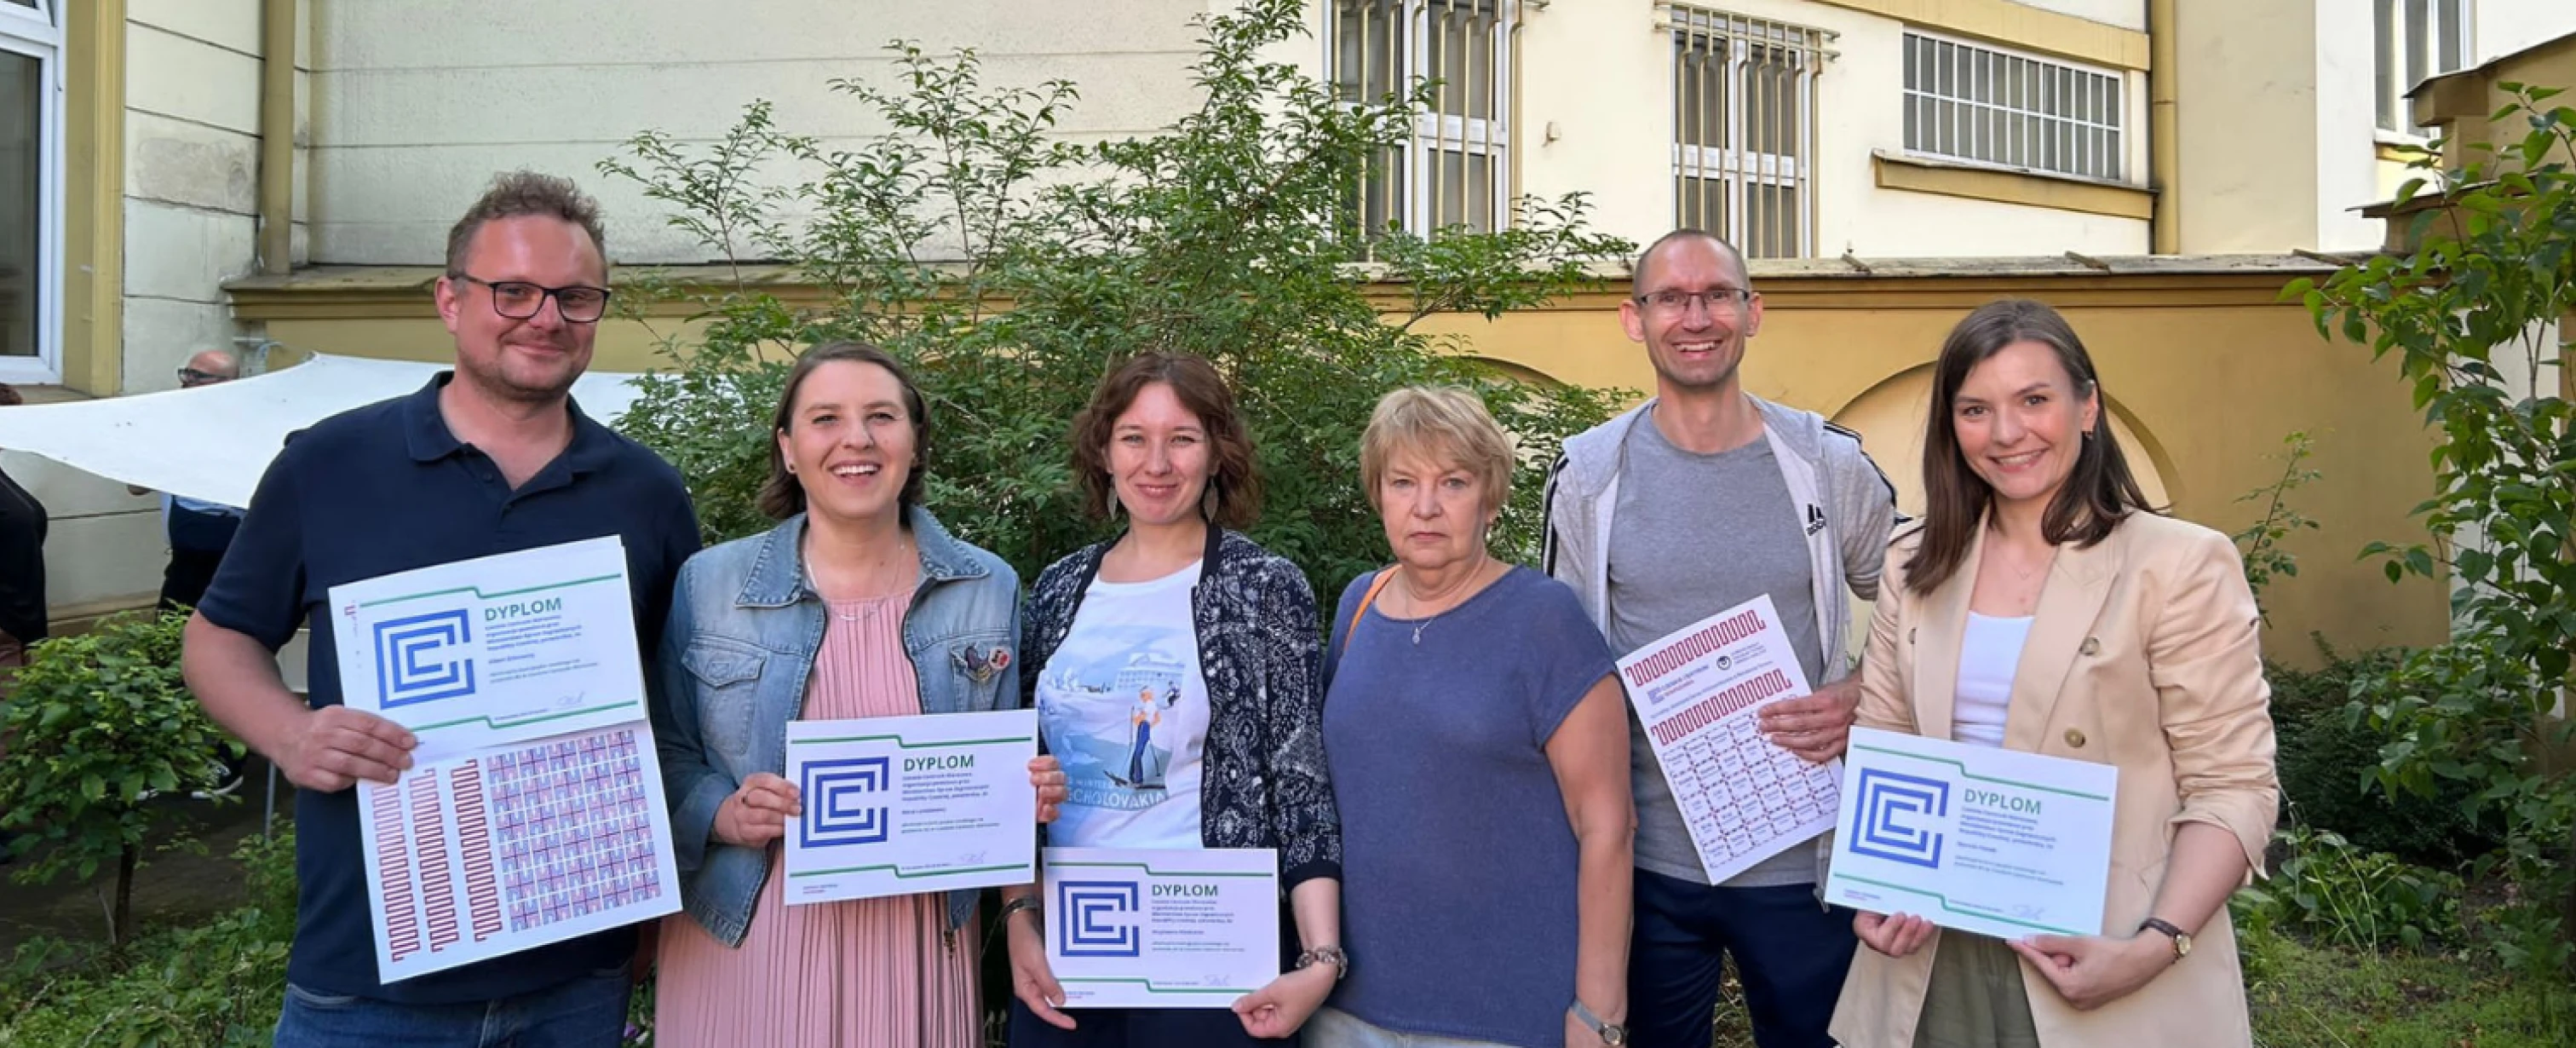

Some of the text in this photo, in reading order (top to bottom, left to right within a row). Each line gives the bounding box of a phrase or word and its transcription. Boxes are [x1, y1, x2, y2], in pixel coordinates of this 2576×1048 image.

[485, 597, 562, 621] DYPLOM
[903, 753, 974, 772] DYPLOM
[1964, 788, 2042, 815] DYPLOM
[1152, 884, 1218, 896] DYPLOM
